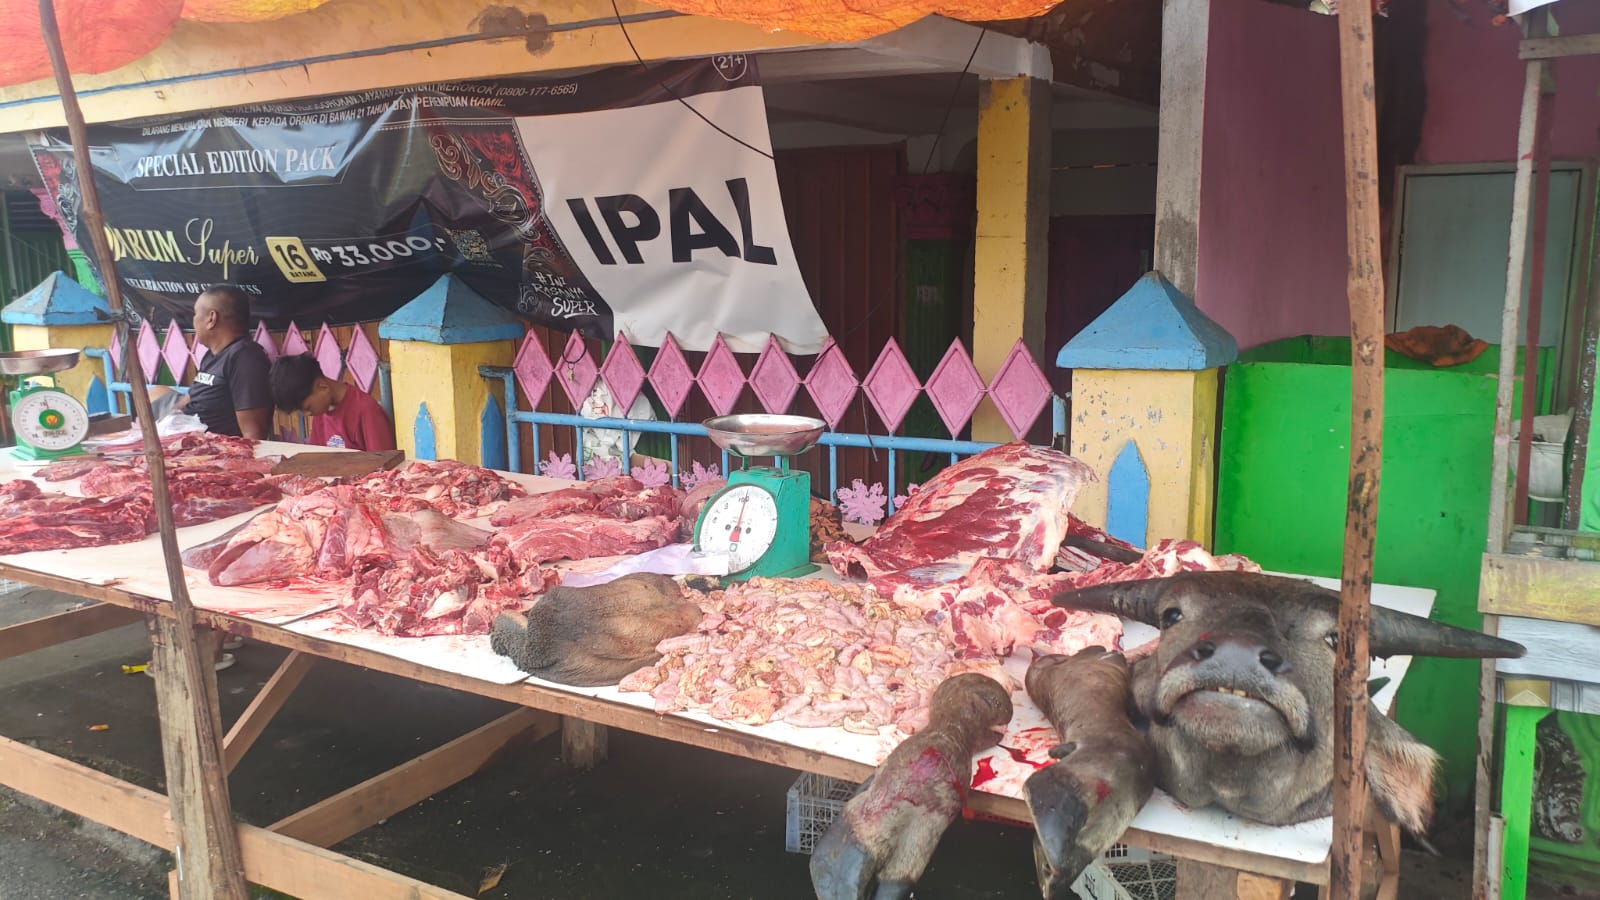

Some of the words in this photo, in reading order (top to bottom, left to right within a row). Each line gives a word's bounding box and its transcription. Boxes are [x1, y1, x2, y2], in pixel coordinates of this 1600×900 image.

[718, 54, 744, 69] 21+
[437, 81, 499, 96] MEROKOK
[496, 83, 578, 97] (0800-177-6565)
[252, 116, 287, 127] KEPADA
[289, 112, 318, 126] ORANG
[320, 112, 328, 123] DI
[329, 108, 356, 122] BAWAH
[357, 107, 365, 119] 21
[366, 102, 390, 117] TAHUN
[392, 98, 415, 111] DAN
[415, 95, 467, 108] PEREMPUAN
[469, 97, 507, 107] HAMIL.
[135, 152, 204, 178] SPECIAL
[206, 149, 277, 175] EDITION
[284, 146, 337, 172] PACK
[565, 177, 778, 266] IPAL
[185, 218, 259, 280] Super
[274, 243, 309, 270] 16
[310, 247, 332, 264] Rp
[186, 282, 201, 294] OF
[551, 297, 598, 317] SUPER
